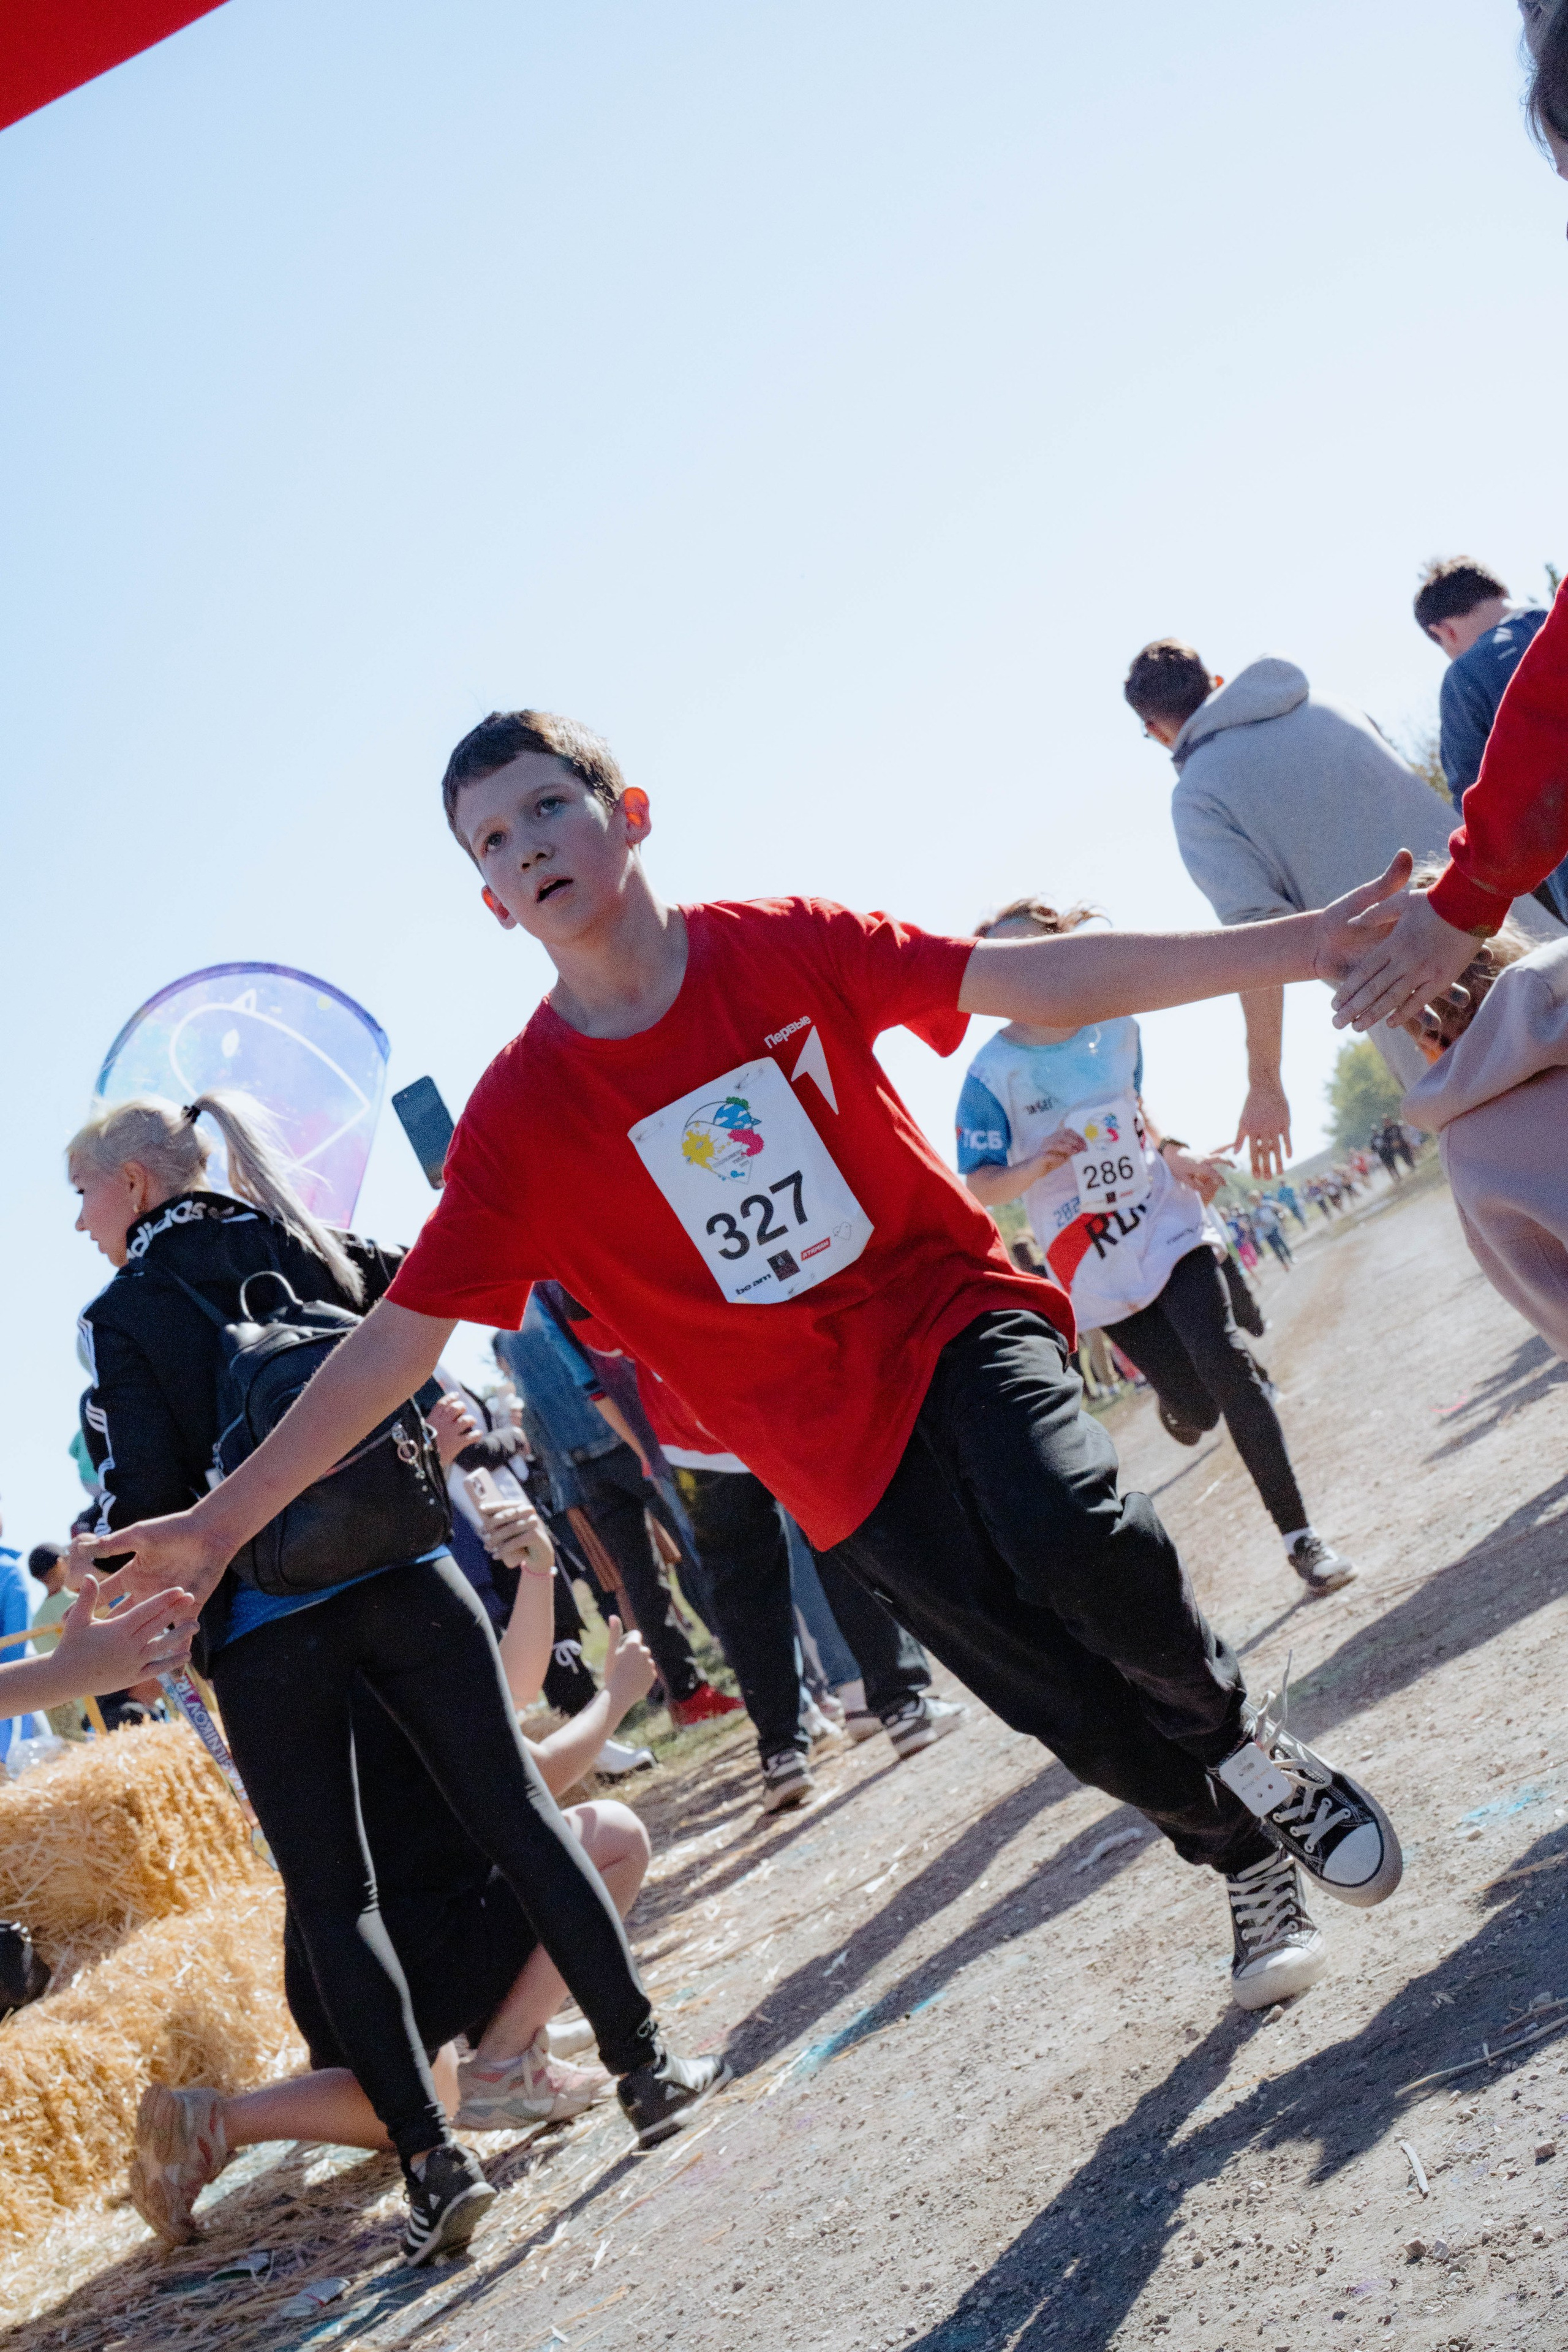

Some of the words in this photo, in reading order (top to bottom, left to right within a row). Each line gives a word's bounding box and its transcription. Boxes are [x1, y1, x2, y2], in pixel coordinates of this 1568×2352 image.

[764, 1016, 811, 1049] Первые
[1083, 1156, 1134, 1189] 286
[706, 1170, 809, 1261] 327
